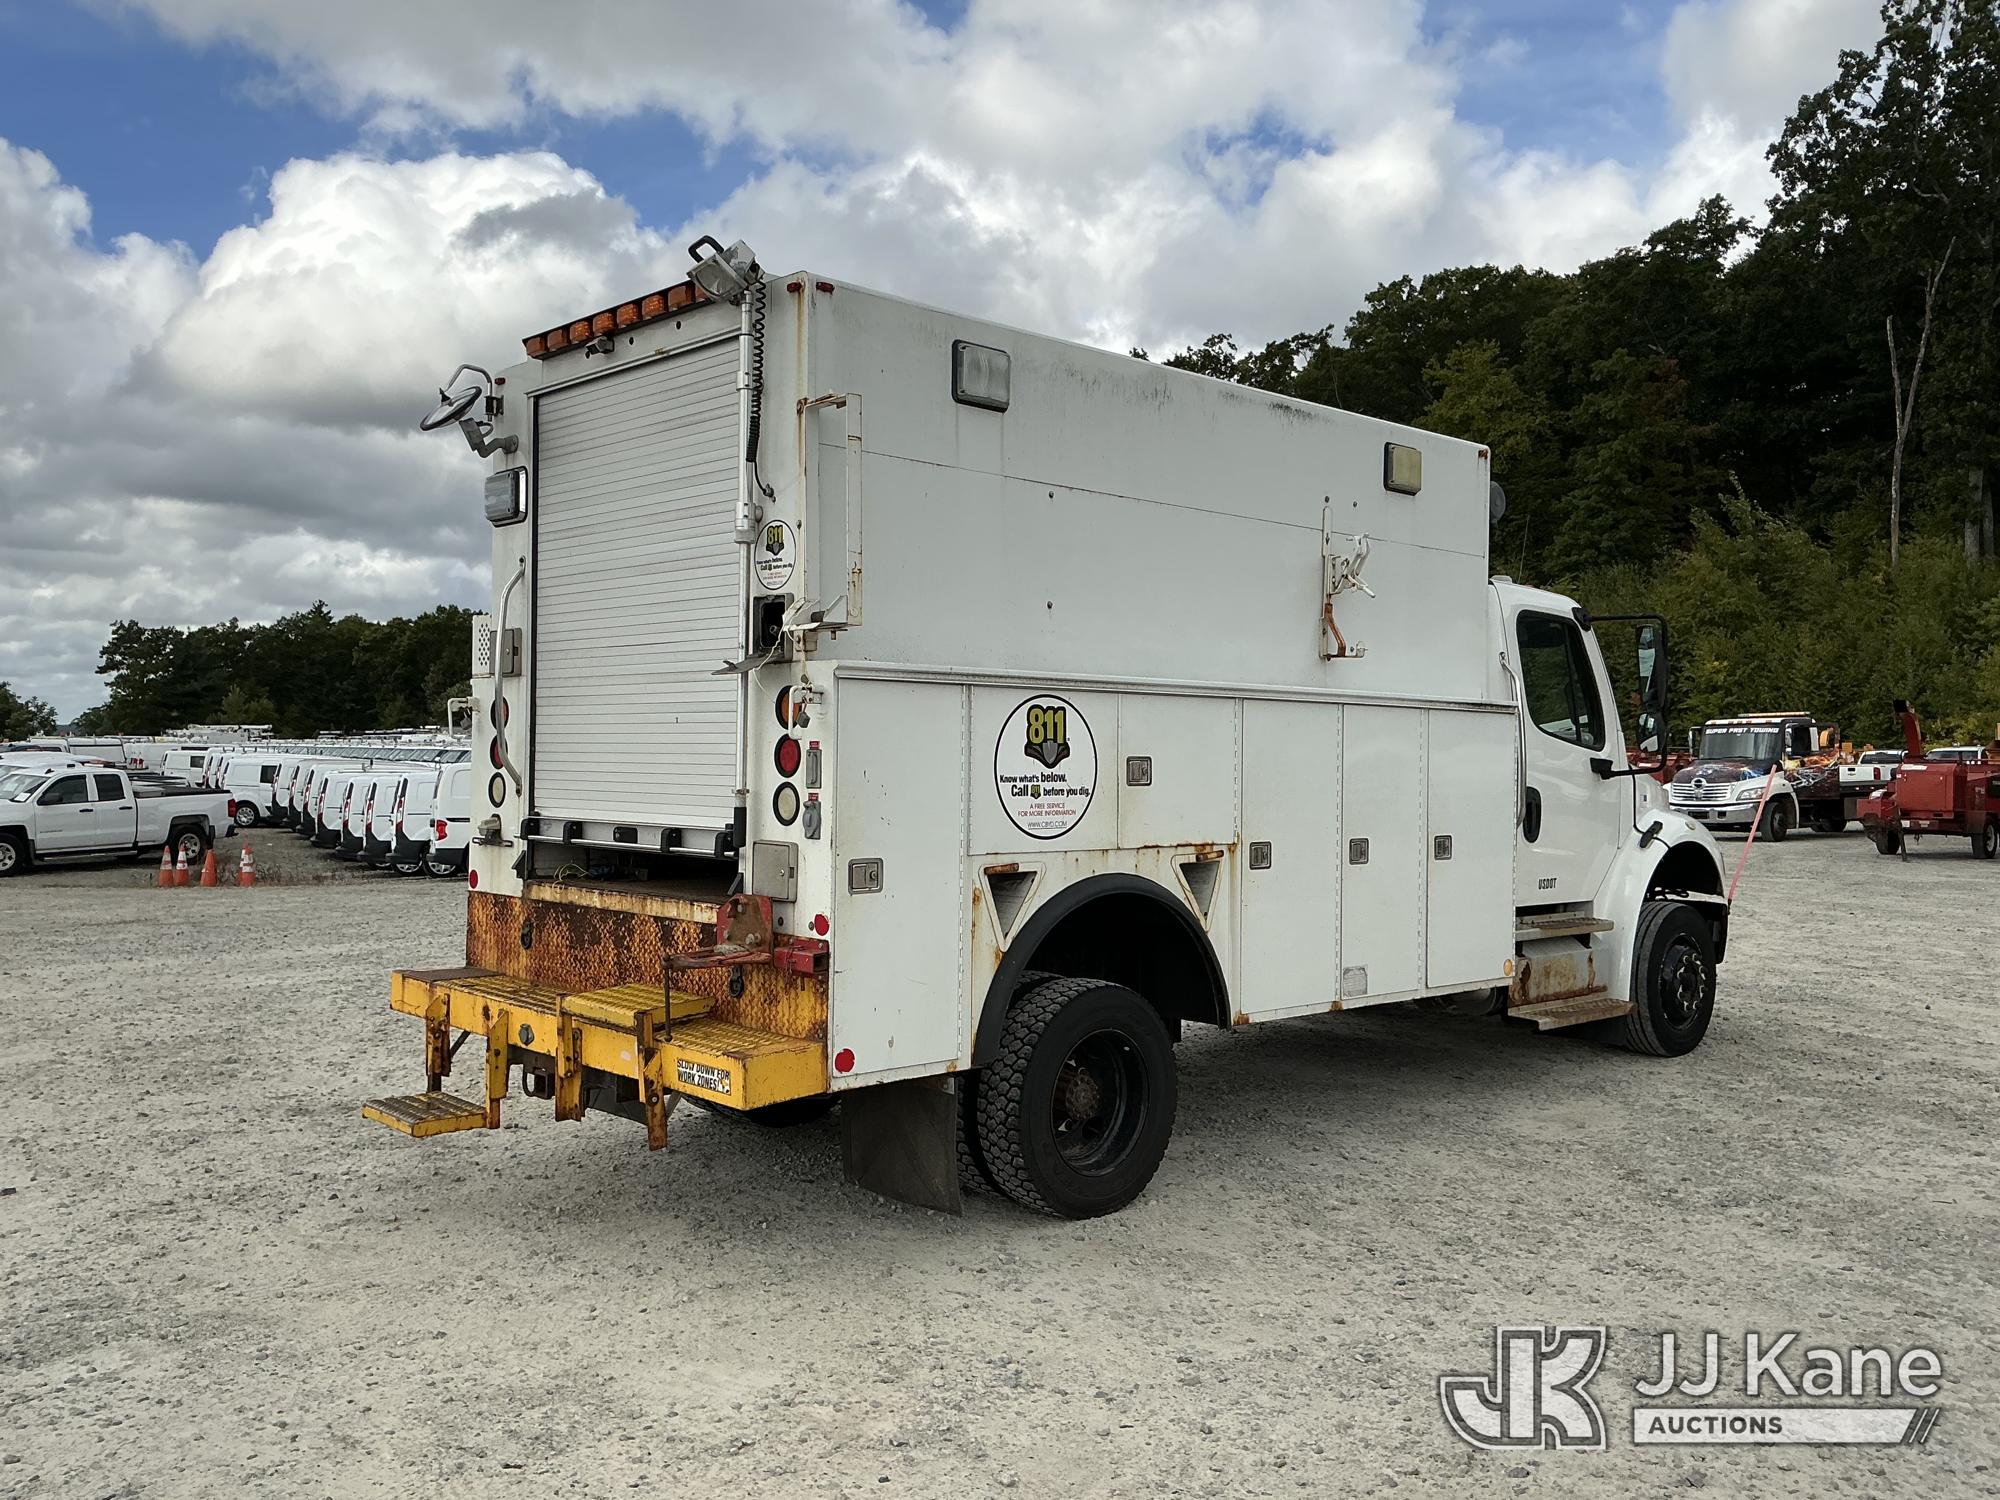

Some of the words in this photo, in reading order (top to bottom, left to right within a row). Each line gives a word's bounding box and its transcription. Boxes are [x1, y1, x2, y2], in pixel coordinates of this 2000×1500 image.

[768, 527, 783, 544] 811
[1029, 707, 1065, 744] 811
[1000, 774, 1017, 783] Know
[1019, 774, 1040, 783] what's
[1041, 772, 1067, 782] below.
[1011, 784, 1028, 796] Call
[1043, 787, 1064, 796] before
[1066, 788, 1078, 798] you
[1079, 786, 1090, 797] dig.
[1538, 877, 1557, 889] USDOT
[677, 1058, 695, 1071] SLOW
[696, 1063, 716, 1077] DOWN
[717, 1068, 730, 1080] FOR
[678, 1069, 696, 1085] WORK
